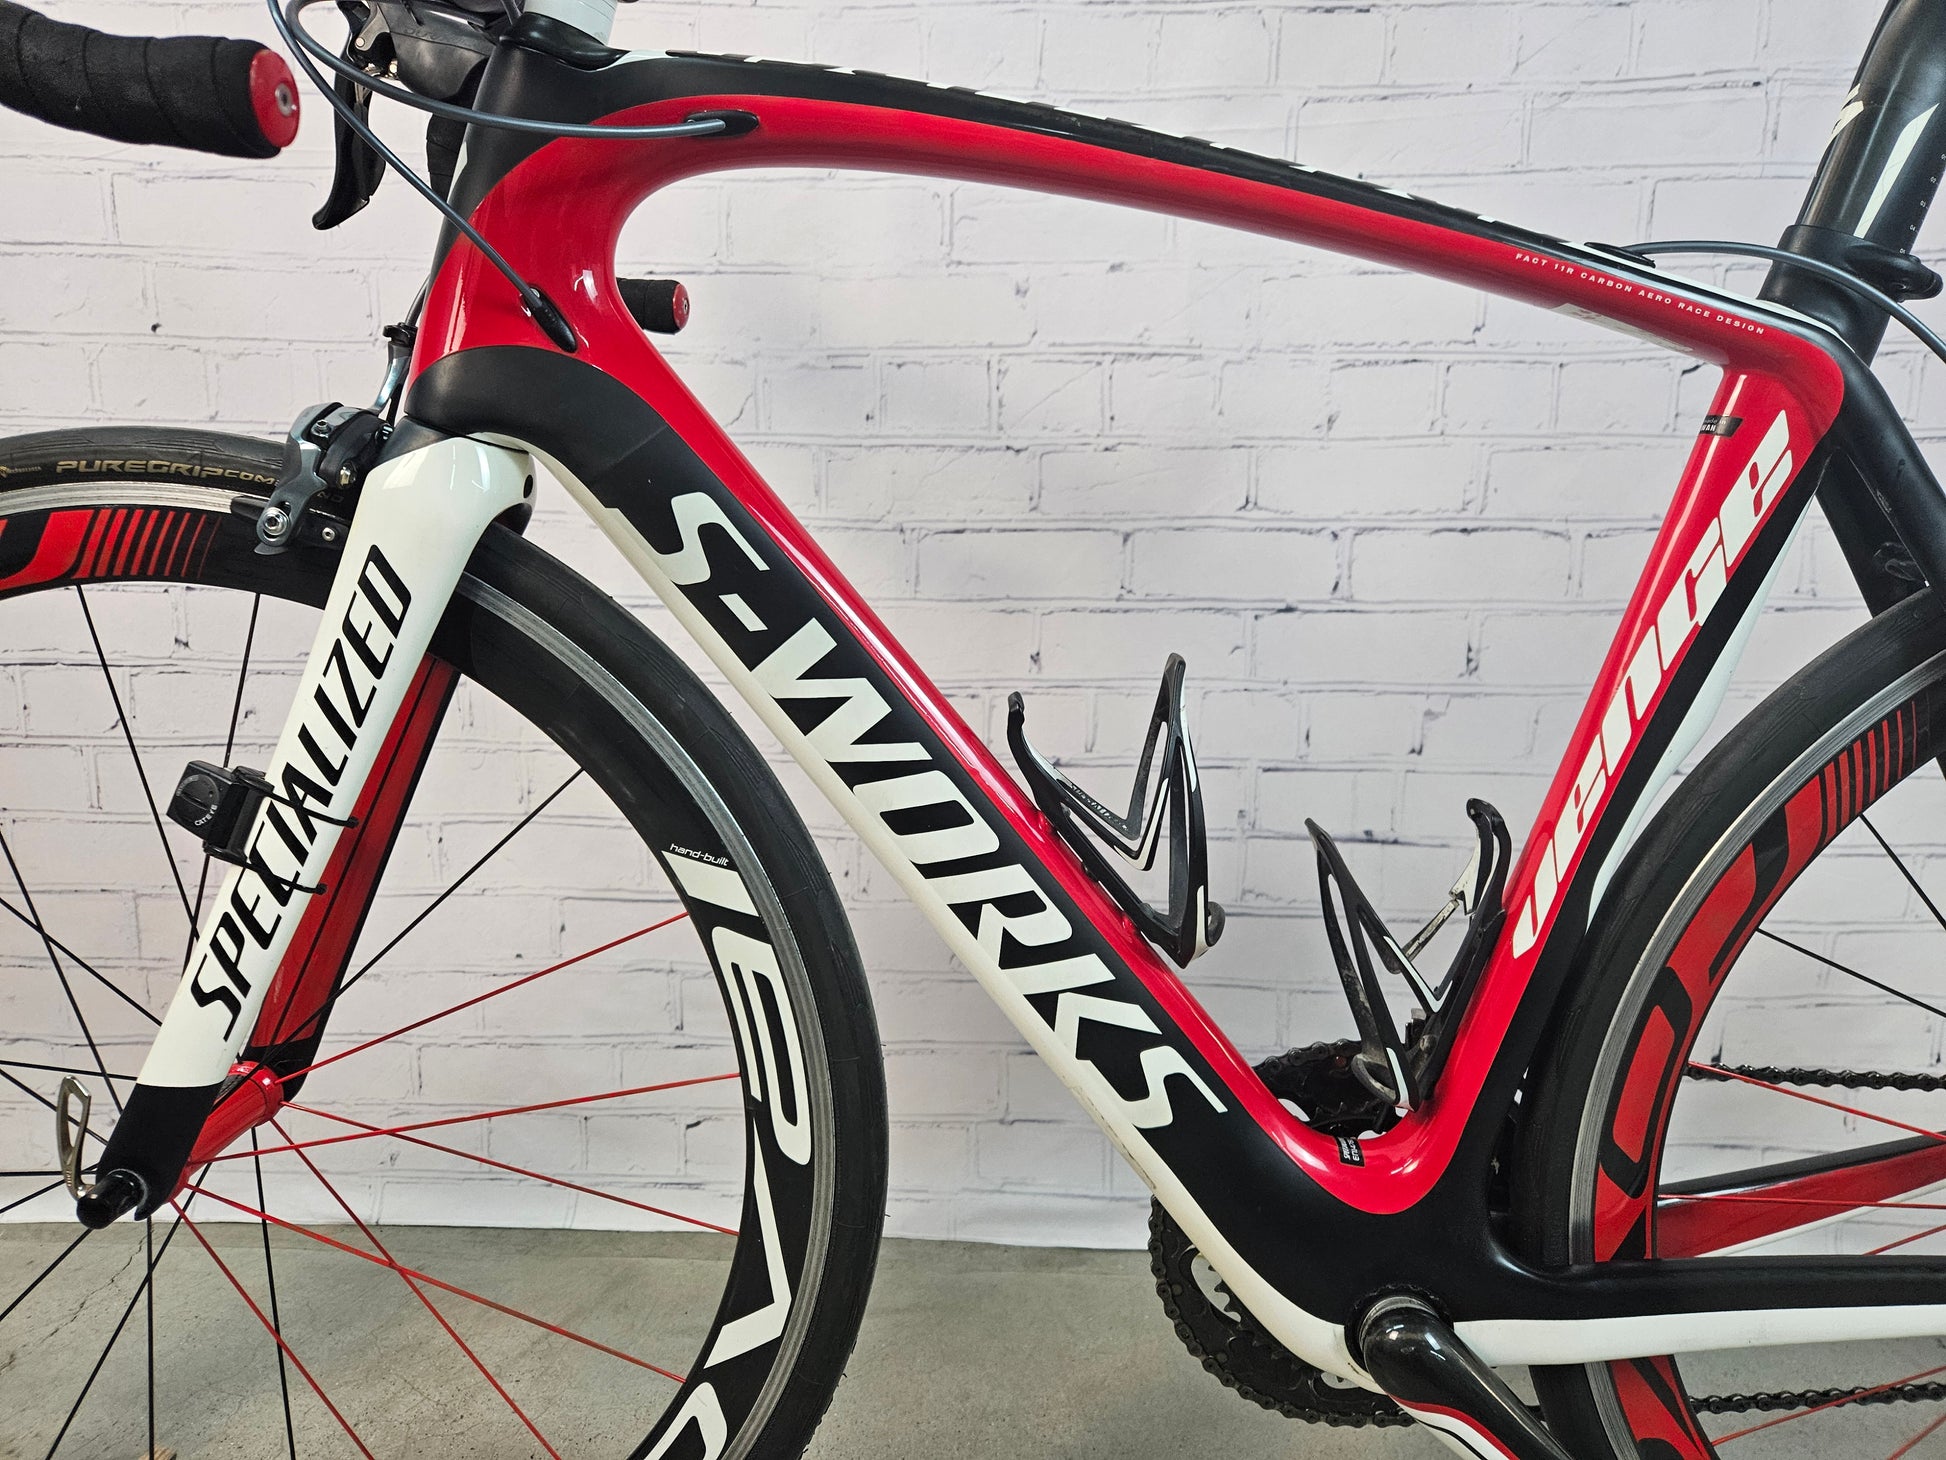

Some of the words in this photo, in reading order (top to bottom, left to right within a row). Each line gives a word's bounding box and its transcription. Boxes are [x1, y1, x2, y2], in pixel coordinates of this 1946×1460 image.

[1515, 253, 1547, 267] FACT
[1554, 263, 1575, 275] 11R
[1580, 272, 1632, 293] CARBON
[1638, 289, 1672, 304] AERO
[1678, 302, 1710, 318] RACE
[1716, 315, 1765, 335] DESIGN
[190, 544, 411, 1041] SPECIALIZED
[658, 492, 1227, 1128] S-WORKS
[670, 844, 728, 865] hand-built
